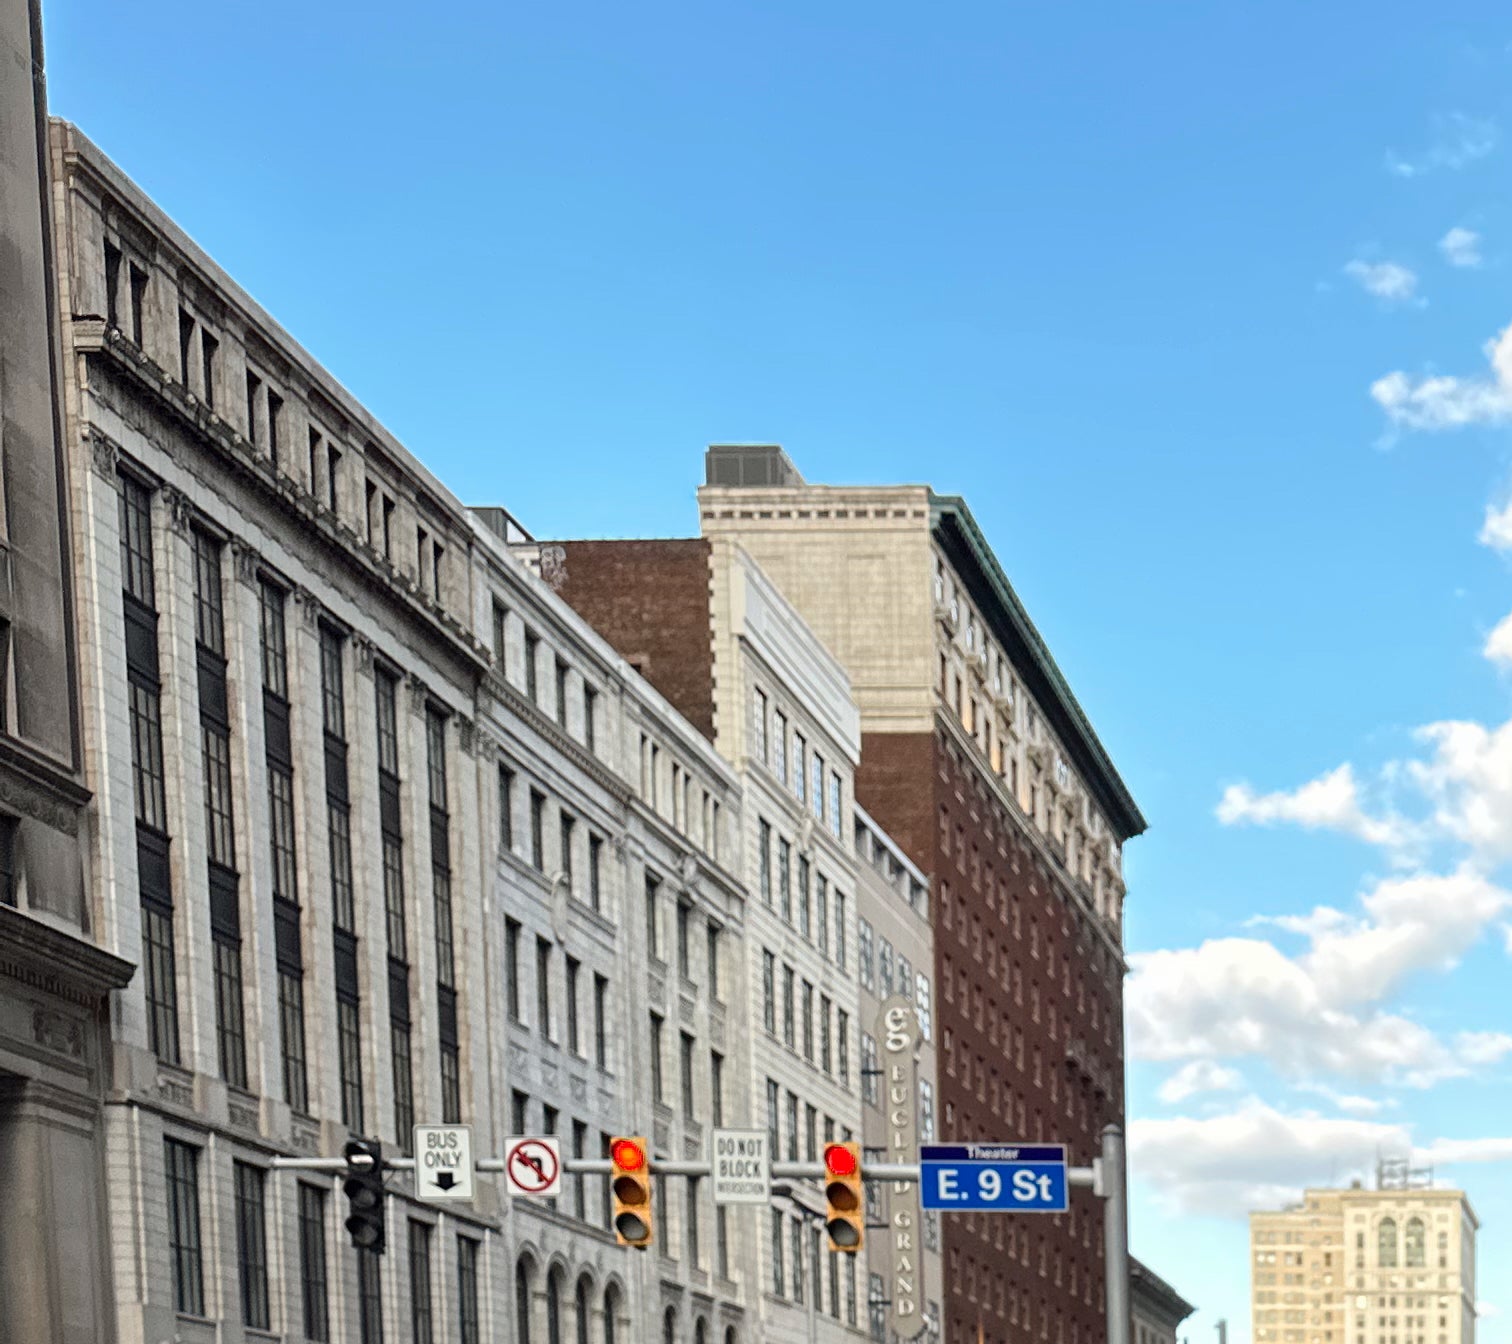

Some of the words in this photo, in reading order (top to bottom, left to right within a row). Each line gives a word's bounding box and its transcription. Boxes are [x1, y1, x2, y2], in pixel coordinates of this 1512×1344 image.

[427, 1132, 458, 1149] BUS
[718, 1138, 735, 1156] DO
[738, 1139, 763, 1157] NOT
[425, 1151, 462, 1169] ONLY
[966, 1146, 1020, 1160] Theater
[720, 1160, 761, 1178] BLOCK
[937, 1168, 969, 1201] E.
[977, 1168, 1002, 1201] 9
[1012, 1168, 1053, 1202] St
[894, 1210, 915, 1317] GRAND
